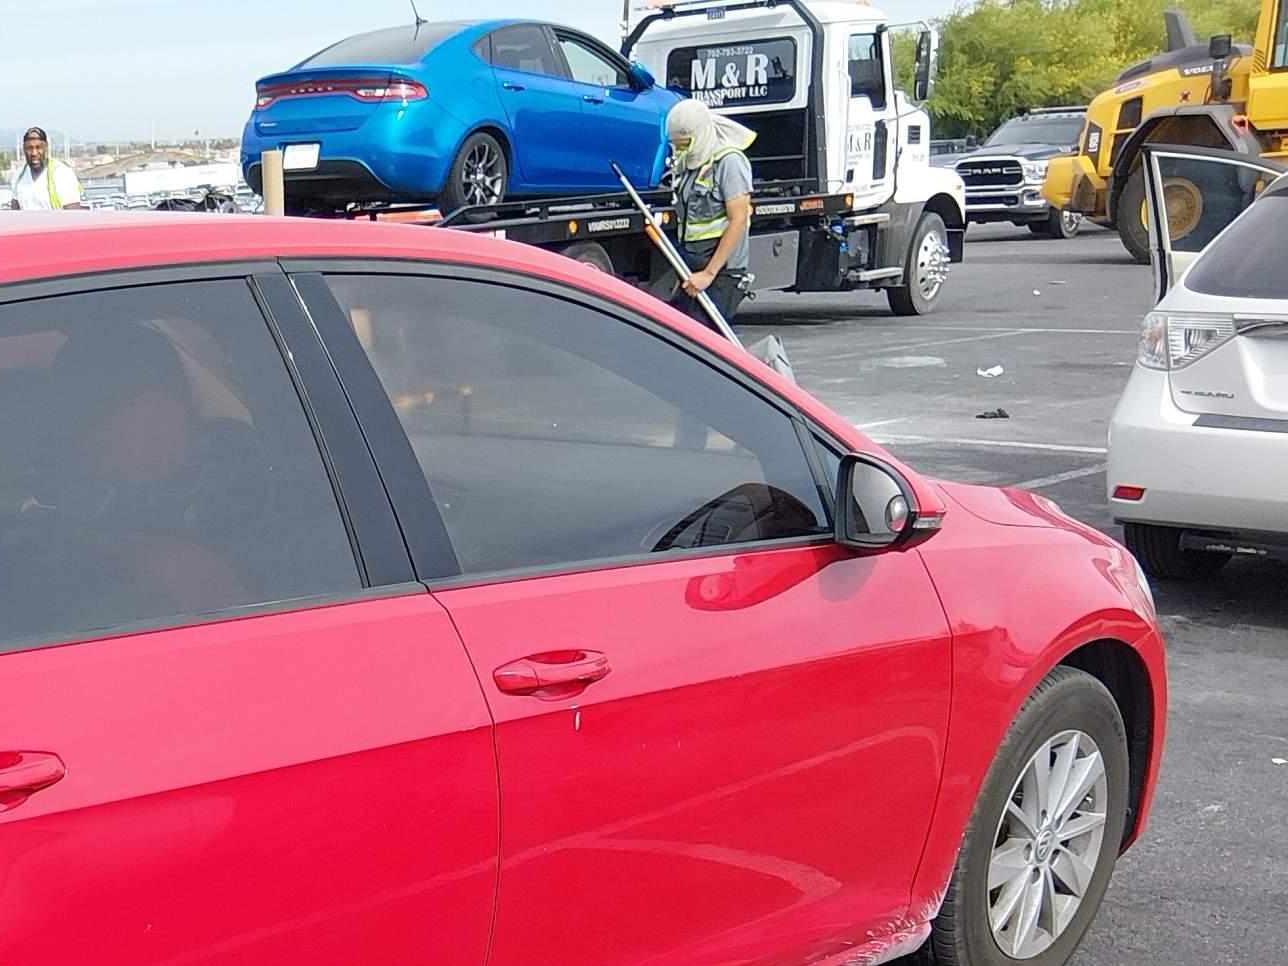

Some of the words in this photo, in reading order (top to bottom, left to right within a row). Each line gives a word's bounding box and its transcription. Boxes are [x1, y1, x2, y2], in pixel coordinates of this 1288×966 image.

[691, 58, 716, 90] M
[721, 62, 740, 88] &
[746, 53, 769, 86] R
[691, 87, 747, 101] TRANSPORT
[749, 85, 768, 97] LLC
[864, 132, 872, 152] R
